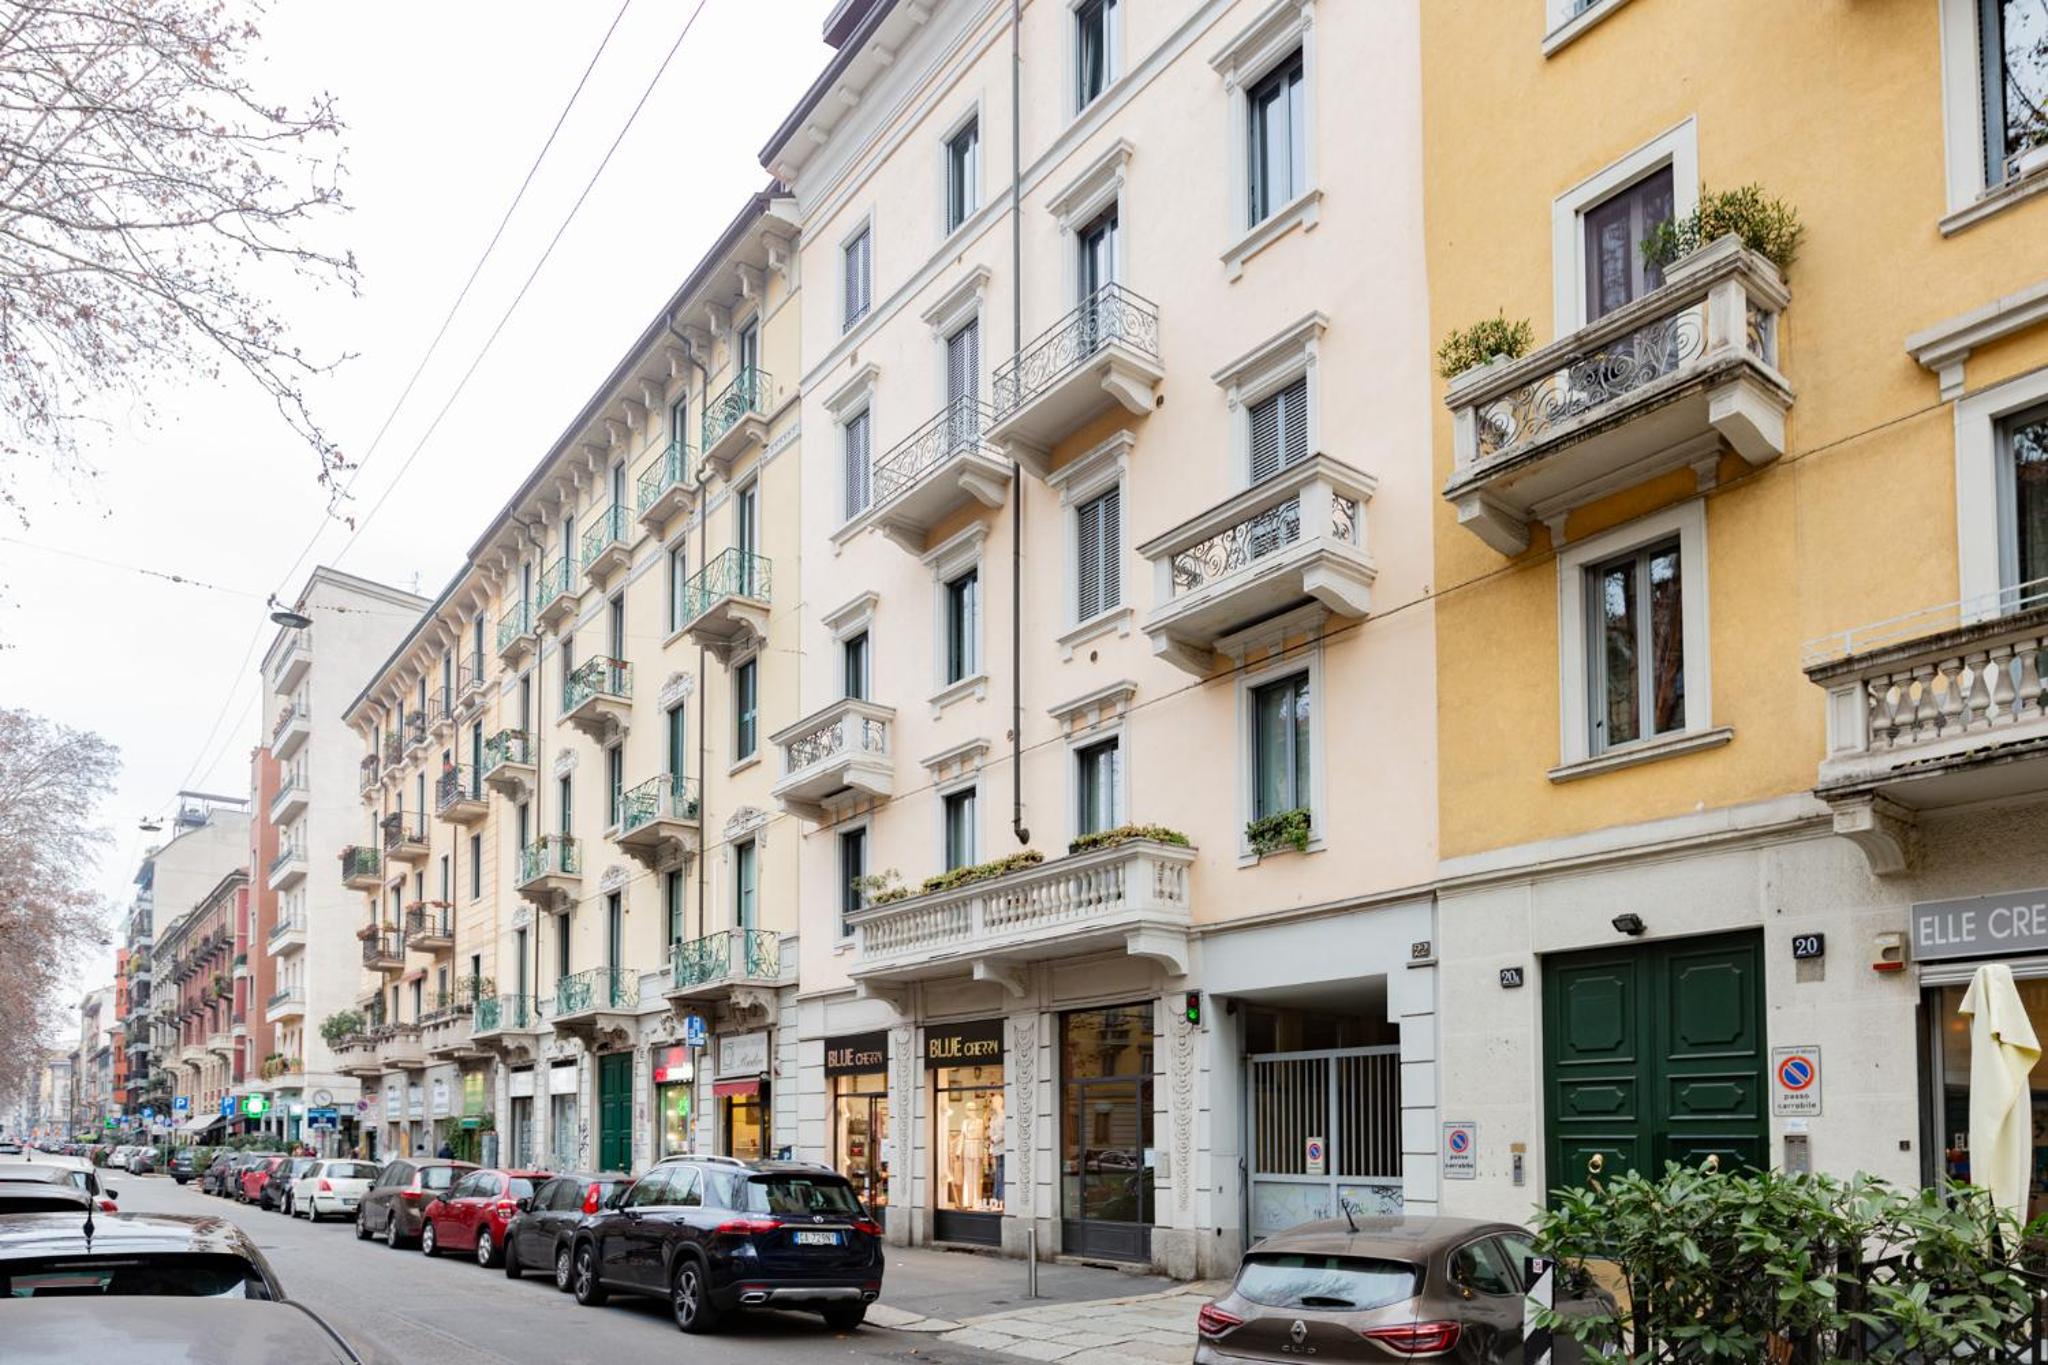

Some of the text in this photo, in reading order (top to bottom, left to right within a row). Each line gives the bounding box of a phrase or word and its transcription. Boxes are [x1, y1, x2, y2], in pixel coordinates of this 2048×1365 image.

[1919, 903, 2048, 946] ELLE CRE
[1413, 941, 1429, 957] 22
[1795, 937, 1818, 955] 20
[929, 1036, 962, 1058] BLUE
[828, 1048, 854, 1067] BLUE
[175, 1098, 186, 1110] P
